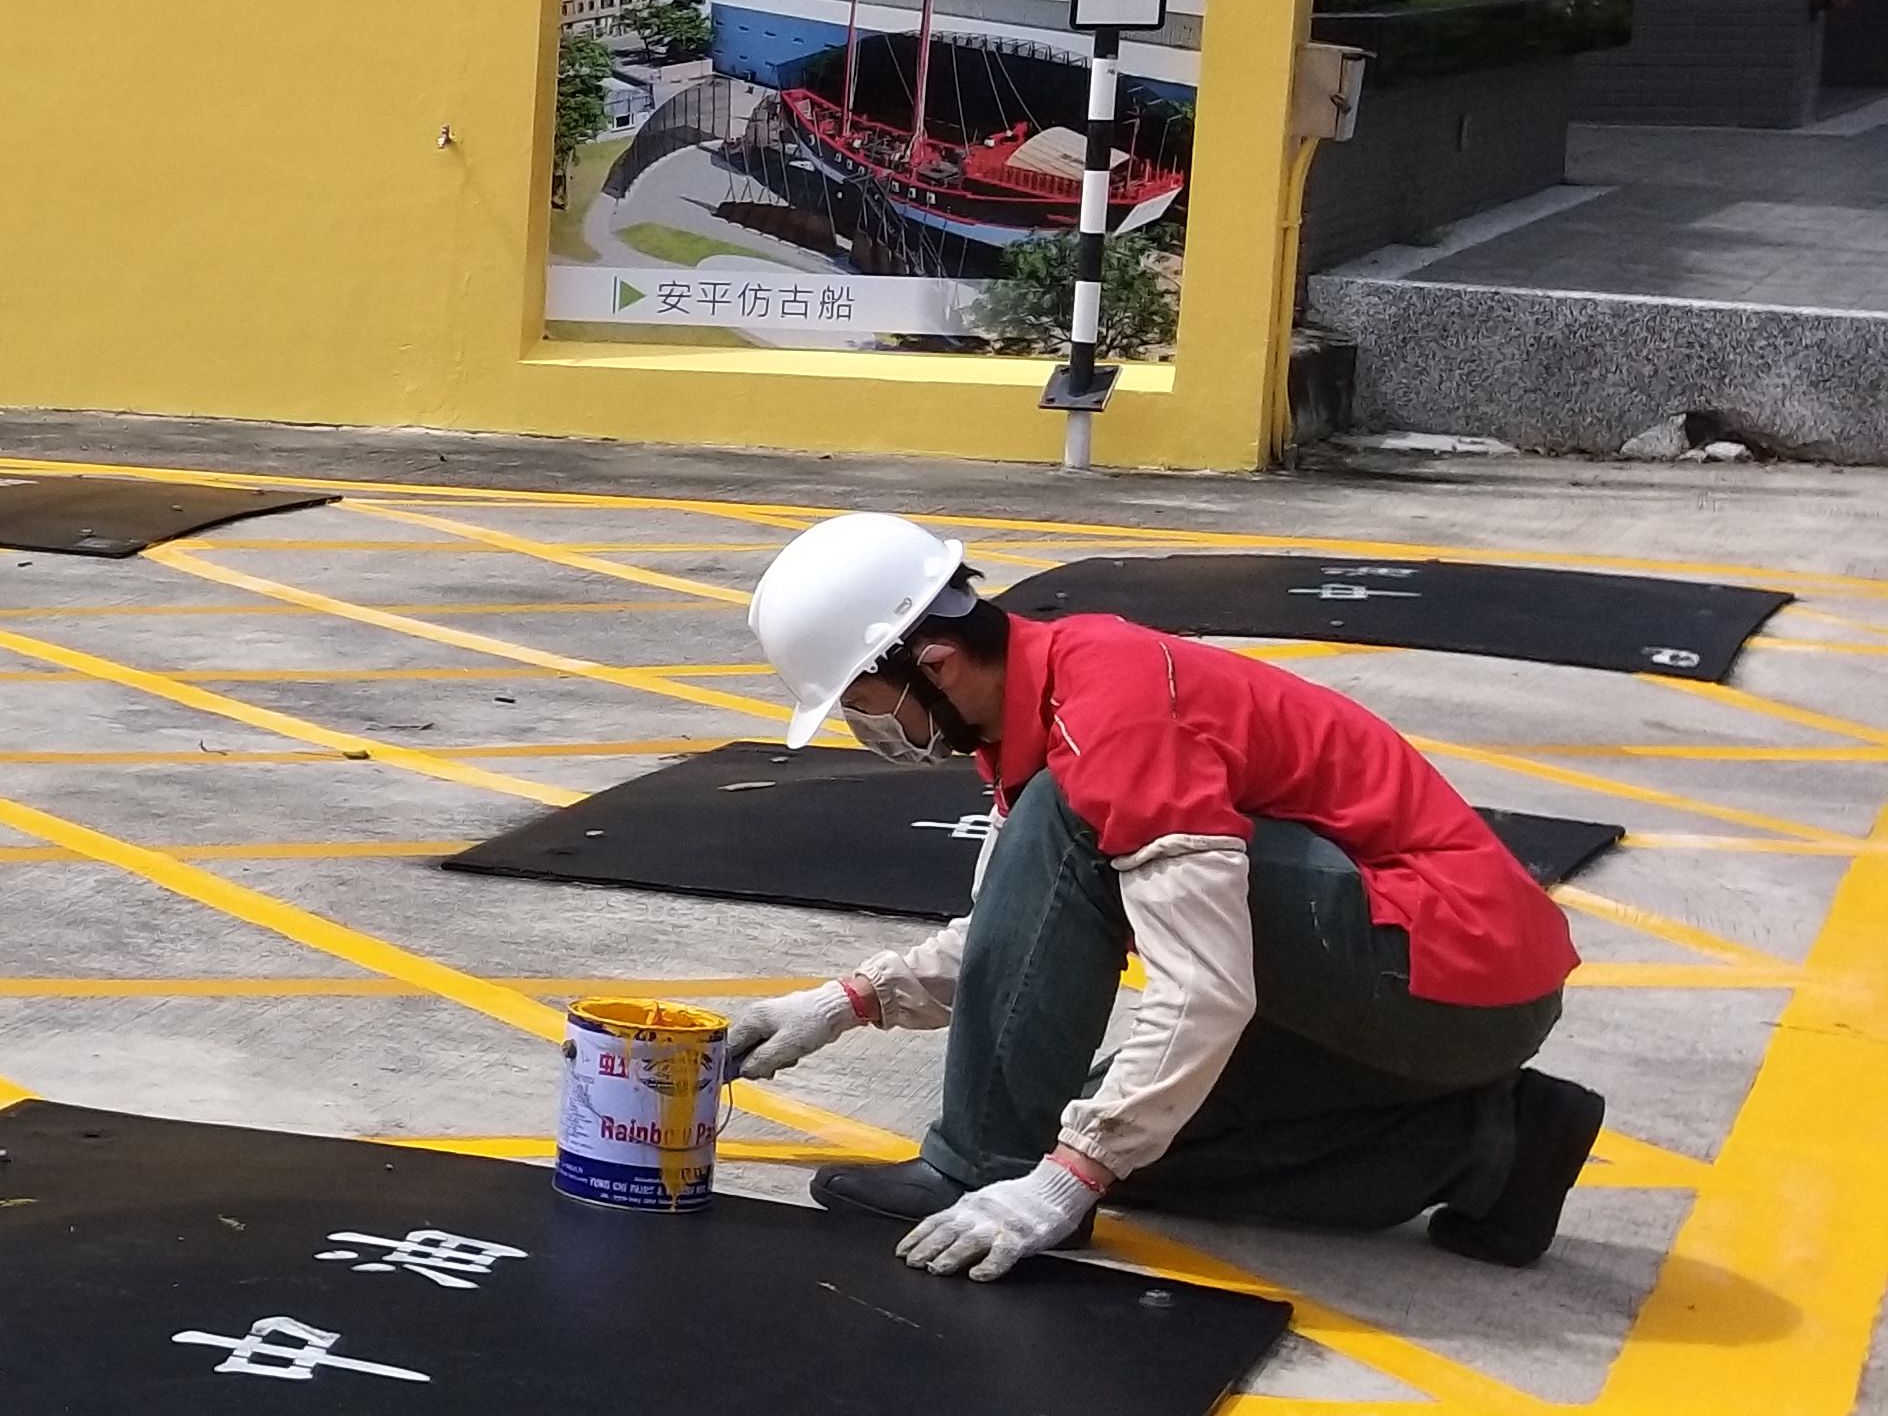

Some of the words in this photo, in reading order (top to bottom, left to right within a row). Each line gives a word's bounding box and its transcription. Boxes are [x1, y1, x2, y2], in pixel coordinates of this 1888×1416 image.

[655, 281, 855, 322] 安平仿古船
[170, 1228, 529, 1383] 中油
